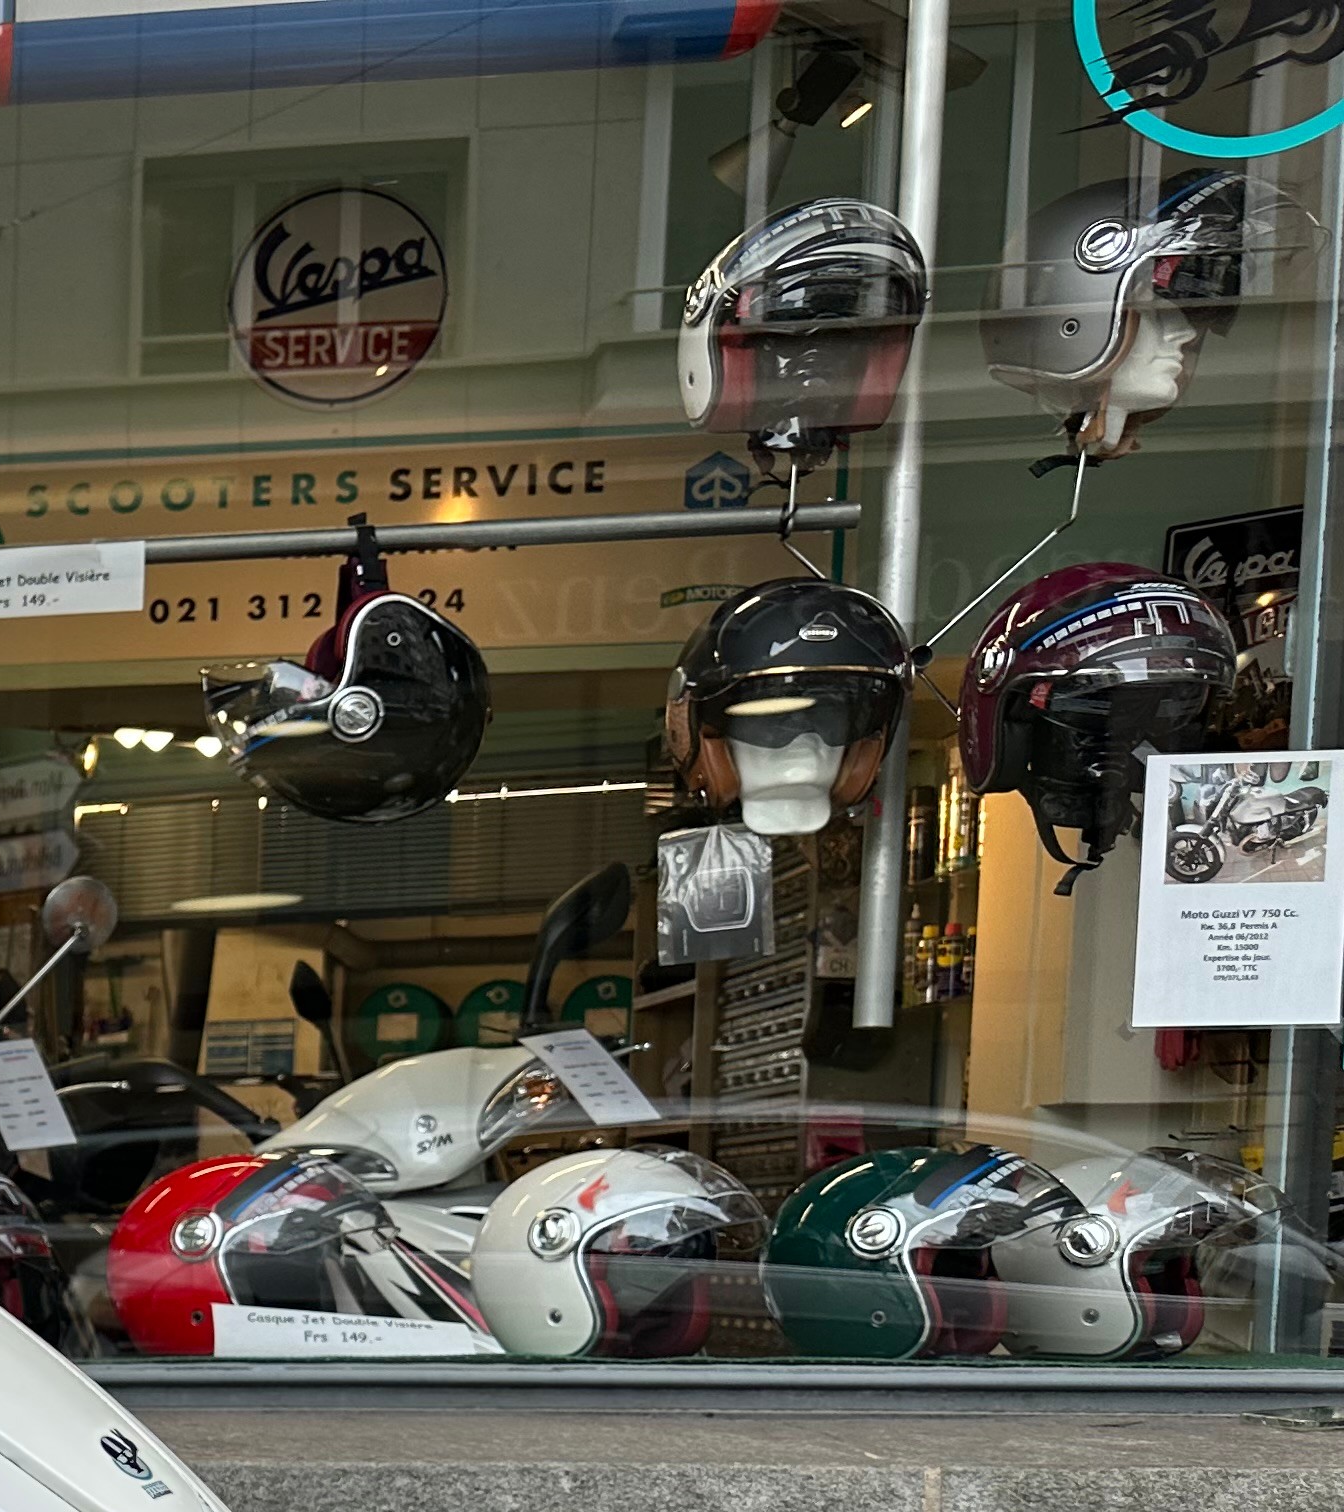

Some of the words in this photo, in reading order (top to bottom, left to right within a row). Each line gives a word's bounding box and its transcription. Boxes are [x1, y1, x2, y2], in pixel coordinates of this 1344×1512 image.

[255, 221, 437, 322] Vespa
[264, 325, 411, 367] SERVICE
[25, 470, 360, 518] SCOOTERS
[389, 460, 606, 501] SERVICE
[18, 573, 60, 586] Double
[686, 586, 744, 602] MOTOR
[149, 597, 220, 624] 021
[247, 592, 322, 621] 312
[418, 588, 465, 613] 24
[1181, 910, 1209, 919] Moto
[1212, 910, 1239, 919] Guzzi
[1242, 909, 1256, 918] V7
[1262, 909, 1281, 918] 750
[417, 1134, 453, 1155] SYM
[247, 1312, 295, 1327] Casque
[302, 1314, 326, 1325] Jet
[304, 1331, 328, 1343] Frs
